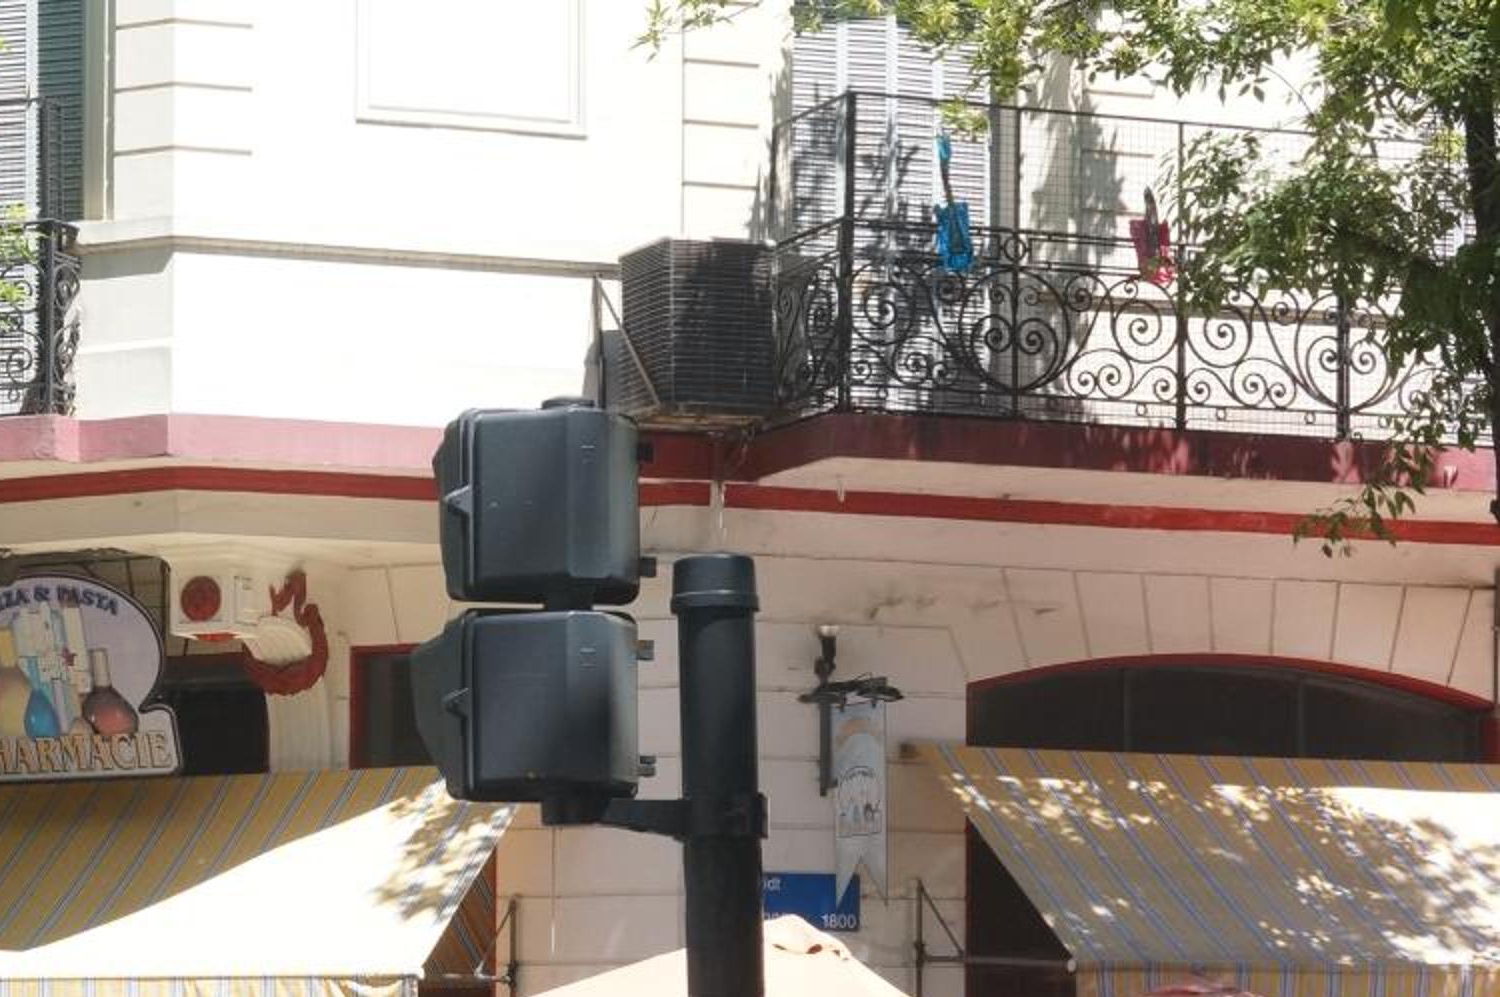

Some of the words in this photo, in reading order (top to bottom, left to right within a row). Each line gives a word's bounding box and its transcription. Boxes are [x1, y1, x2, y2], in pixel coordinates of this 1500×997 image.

[33, 587, 49, 601] &
[57, 587, 118, 615] PASTA
[820, 913, 857, 929] 1800
